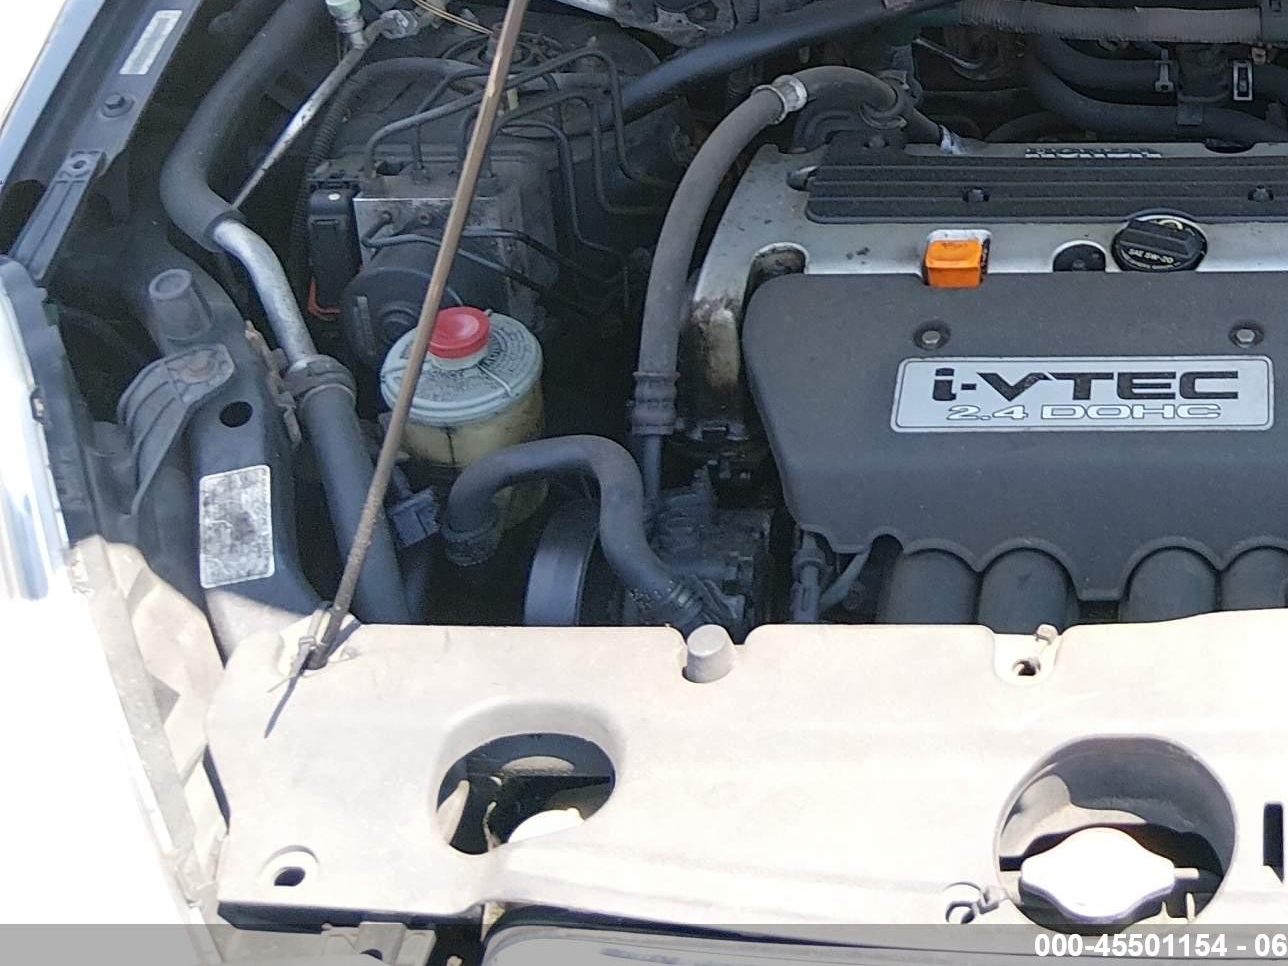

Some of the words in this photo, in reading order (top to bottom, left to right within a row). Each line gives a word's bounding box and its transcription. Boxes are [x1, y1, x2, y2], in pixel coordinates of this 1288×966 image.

[1144, 251, 1174, 264] 5W-20
[932, 367, 1239, 402] i-VTEC
[946, 404, 1029, 421] 2.4
[1040, 404, 1222, 420] DOHC
